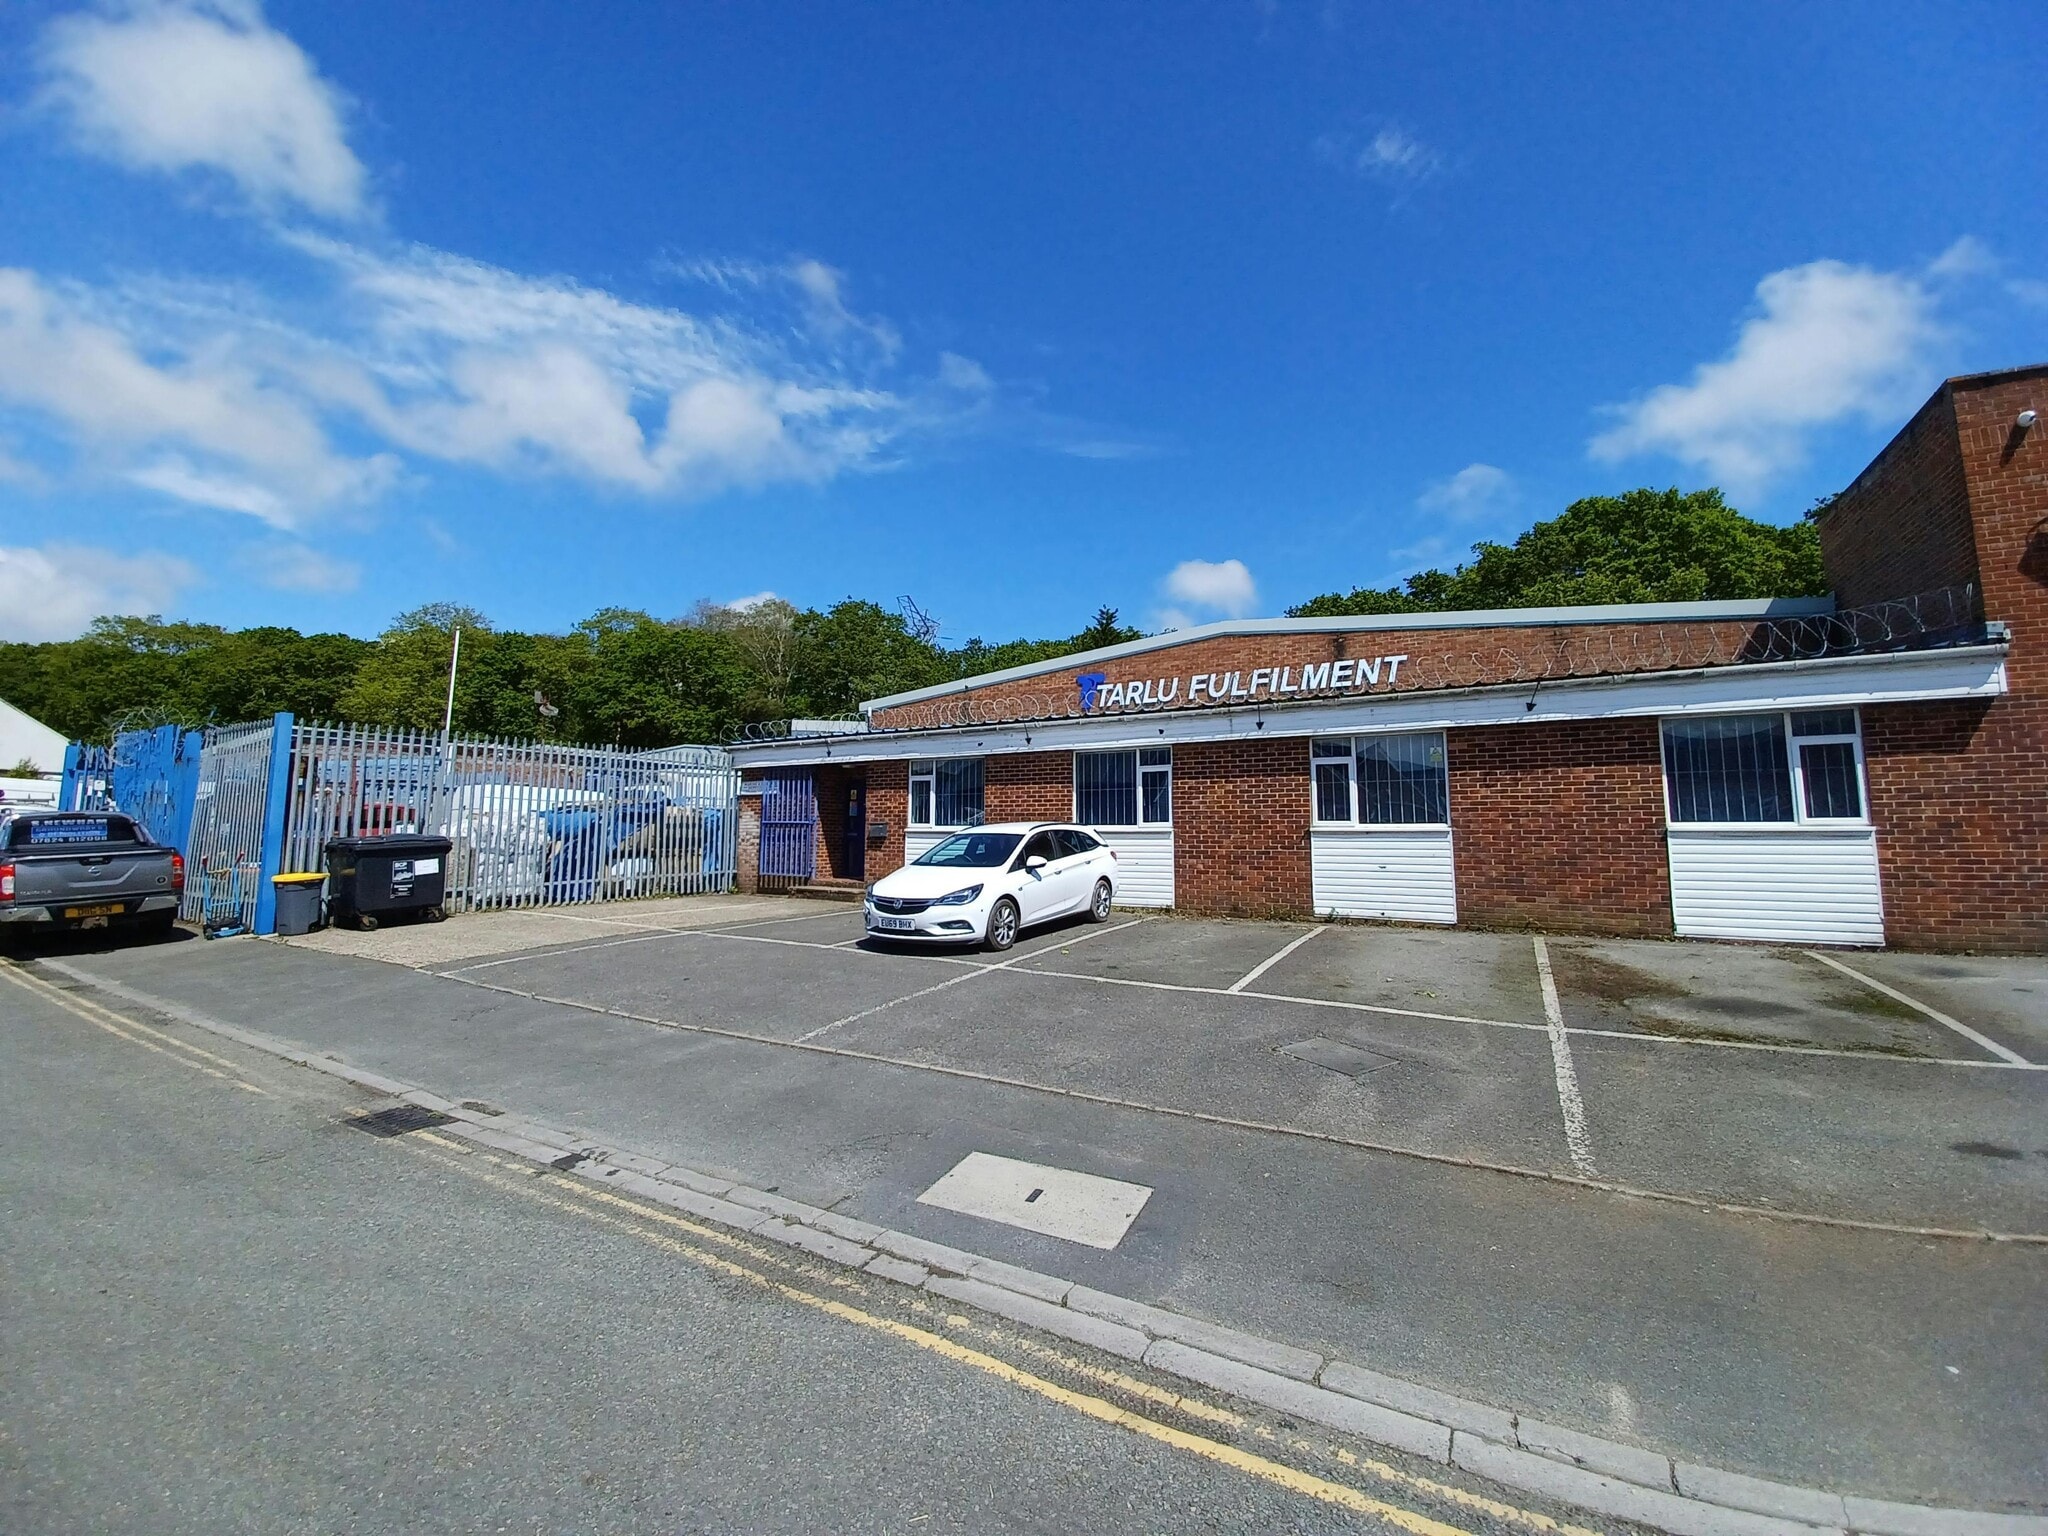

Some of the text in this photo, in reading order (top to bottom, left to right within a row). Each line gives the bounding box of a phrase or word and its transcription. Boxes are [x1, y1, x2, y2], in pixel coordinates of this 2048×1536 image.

[1097, 655, 1408, 707] TARLU FULFILMENT
[881, 919, 912, 928] EU69 BHX
